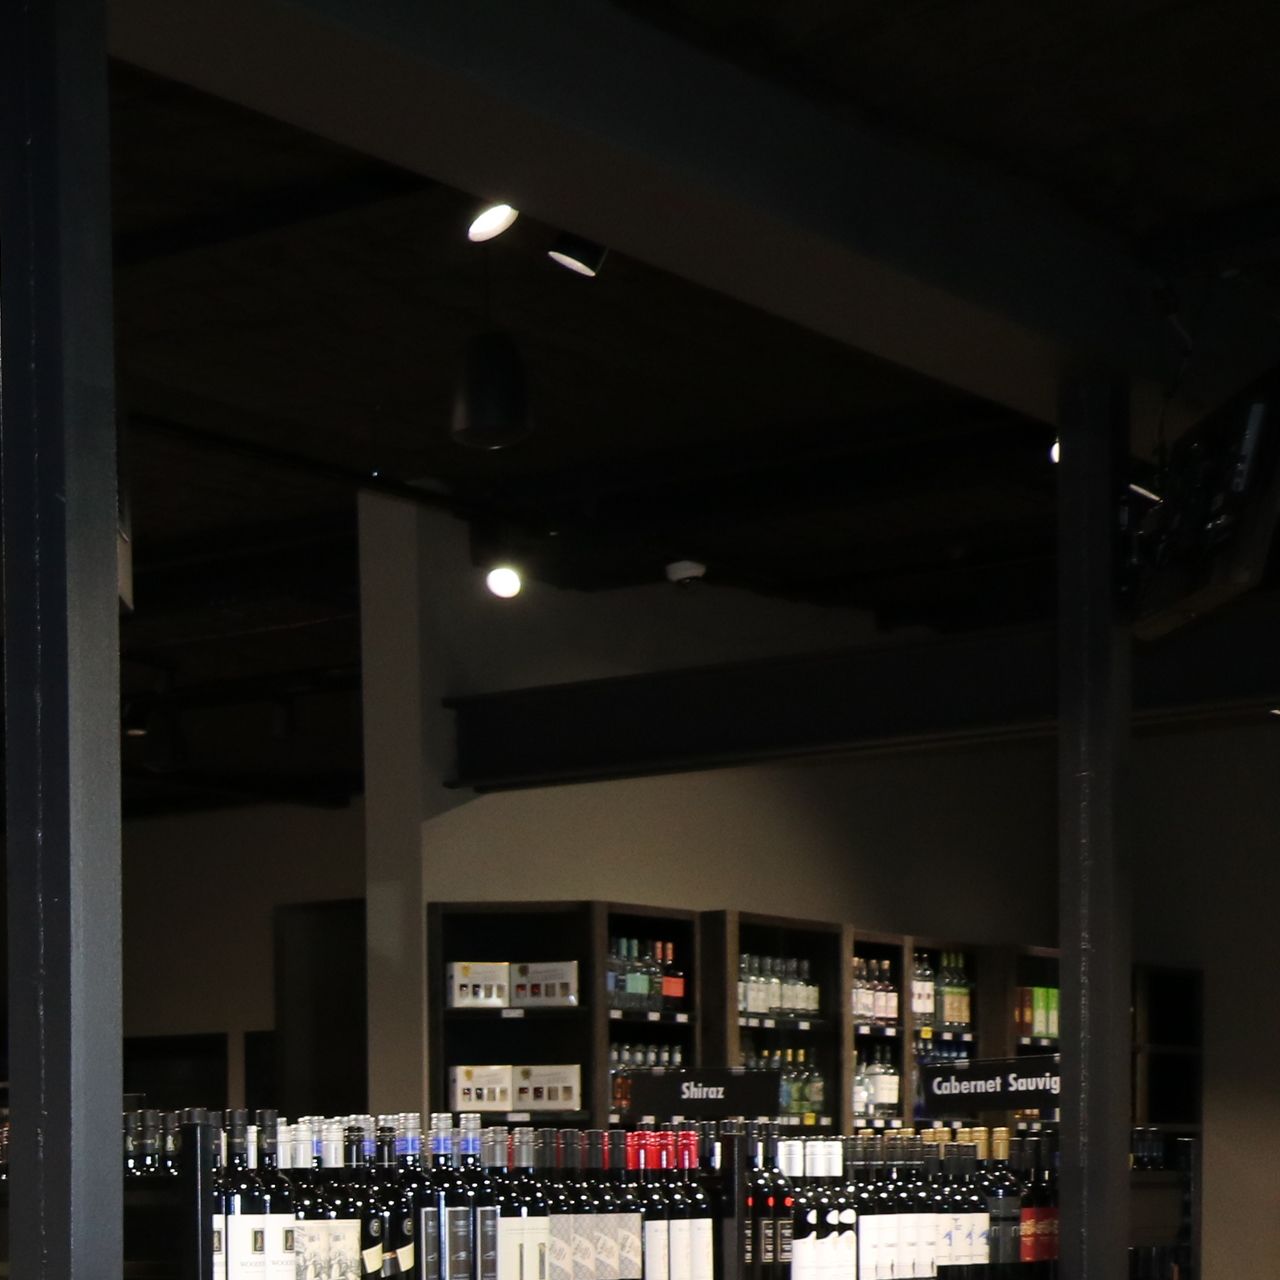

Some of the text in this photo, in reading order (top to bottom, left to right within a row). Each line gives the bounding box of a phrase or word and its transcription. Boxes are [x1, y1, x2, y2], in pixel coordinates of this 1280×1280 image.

[681, 1081, 725, 1099] Shiraz
[932, 1071, 1060, 1096] Cabernet Sauvig
